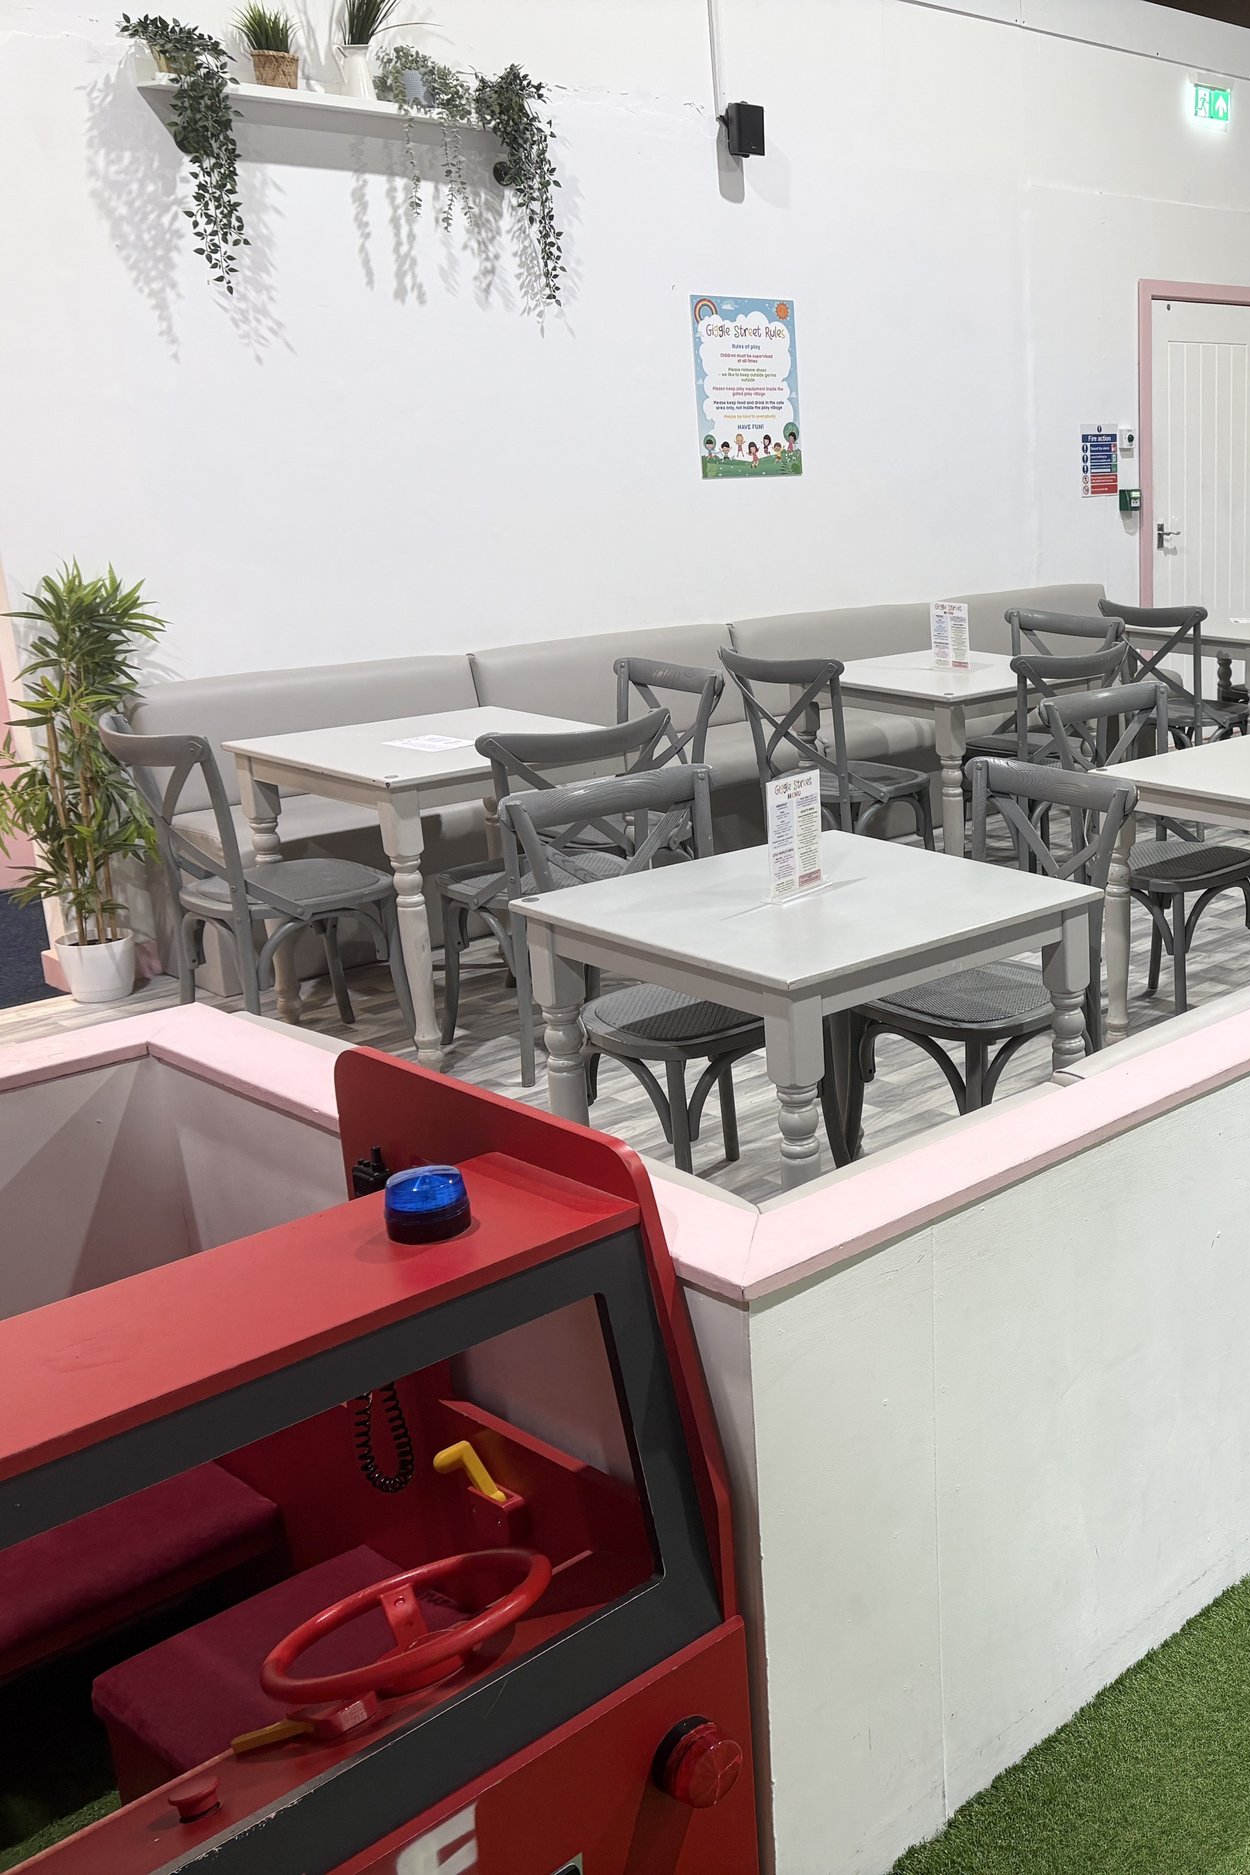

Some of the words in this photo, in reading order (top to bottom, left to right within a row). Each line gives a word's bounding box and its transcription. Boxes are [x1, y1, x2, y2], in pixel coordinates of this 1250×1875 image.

[706, 324, 730, 337] Giggle
[734, 325, 761, 338] Street
[765, 326, 785, 340] Rules
[775, 783, 791, 795] Giggle
[794, 776, 812, 790] Street
